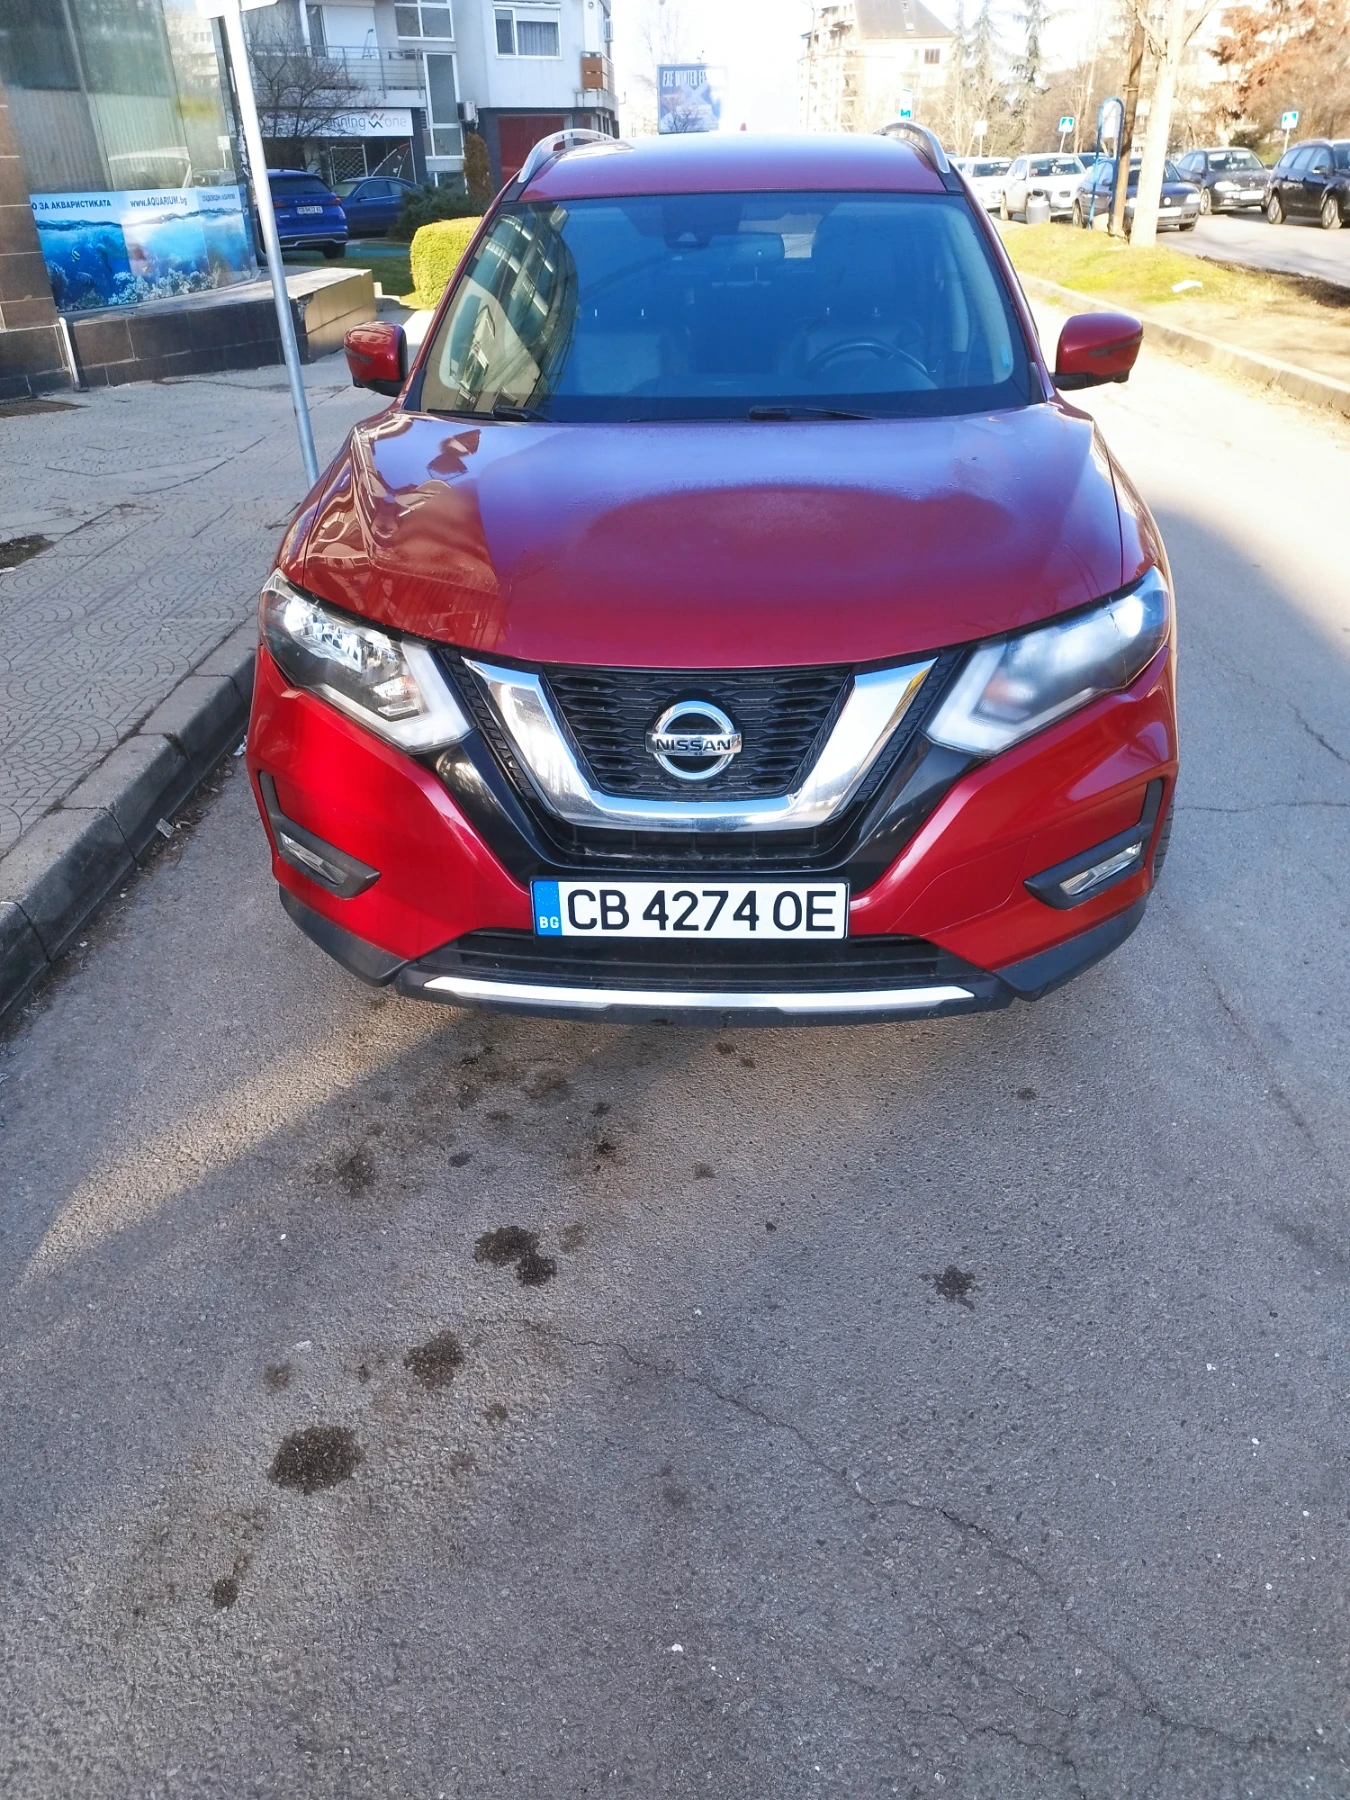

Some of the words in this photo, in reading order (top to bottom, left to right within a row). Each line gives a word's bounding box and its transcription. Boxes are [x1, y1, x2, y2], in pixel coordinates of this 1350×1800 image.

[40, 202, 50, 210] ЗА
[51, 199, 112, 210] АКВАРИСТИКАТА
[130, 195, 188, 207] www.AQUARIUM.bg
[656, 739, 731, 751] NISSAN
[539, 916, 559, 929] BG
[567, 889, 630, 930] CB
[642, 889, 760, 931] 4274
[772, 890, 836, 932] OE
